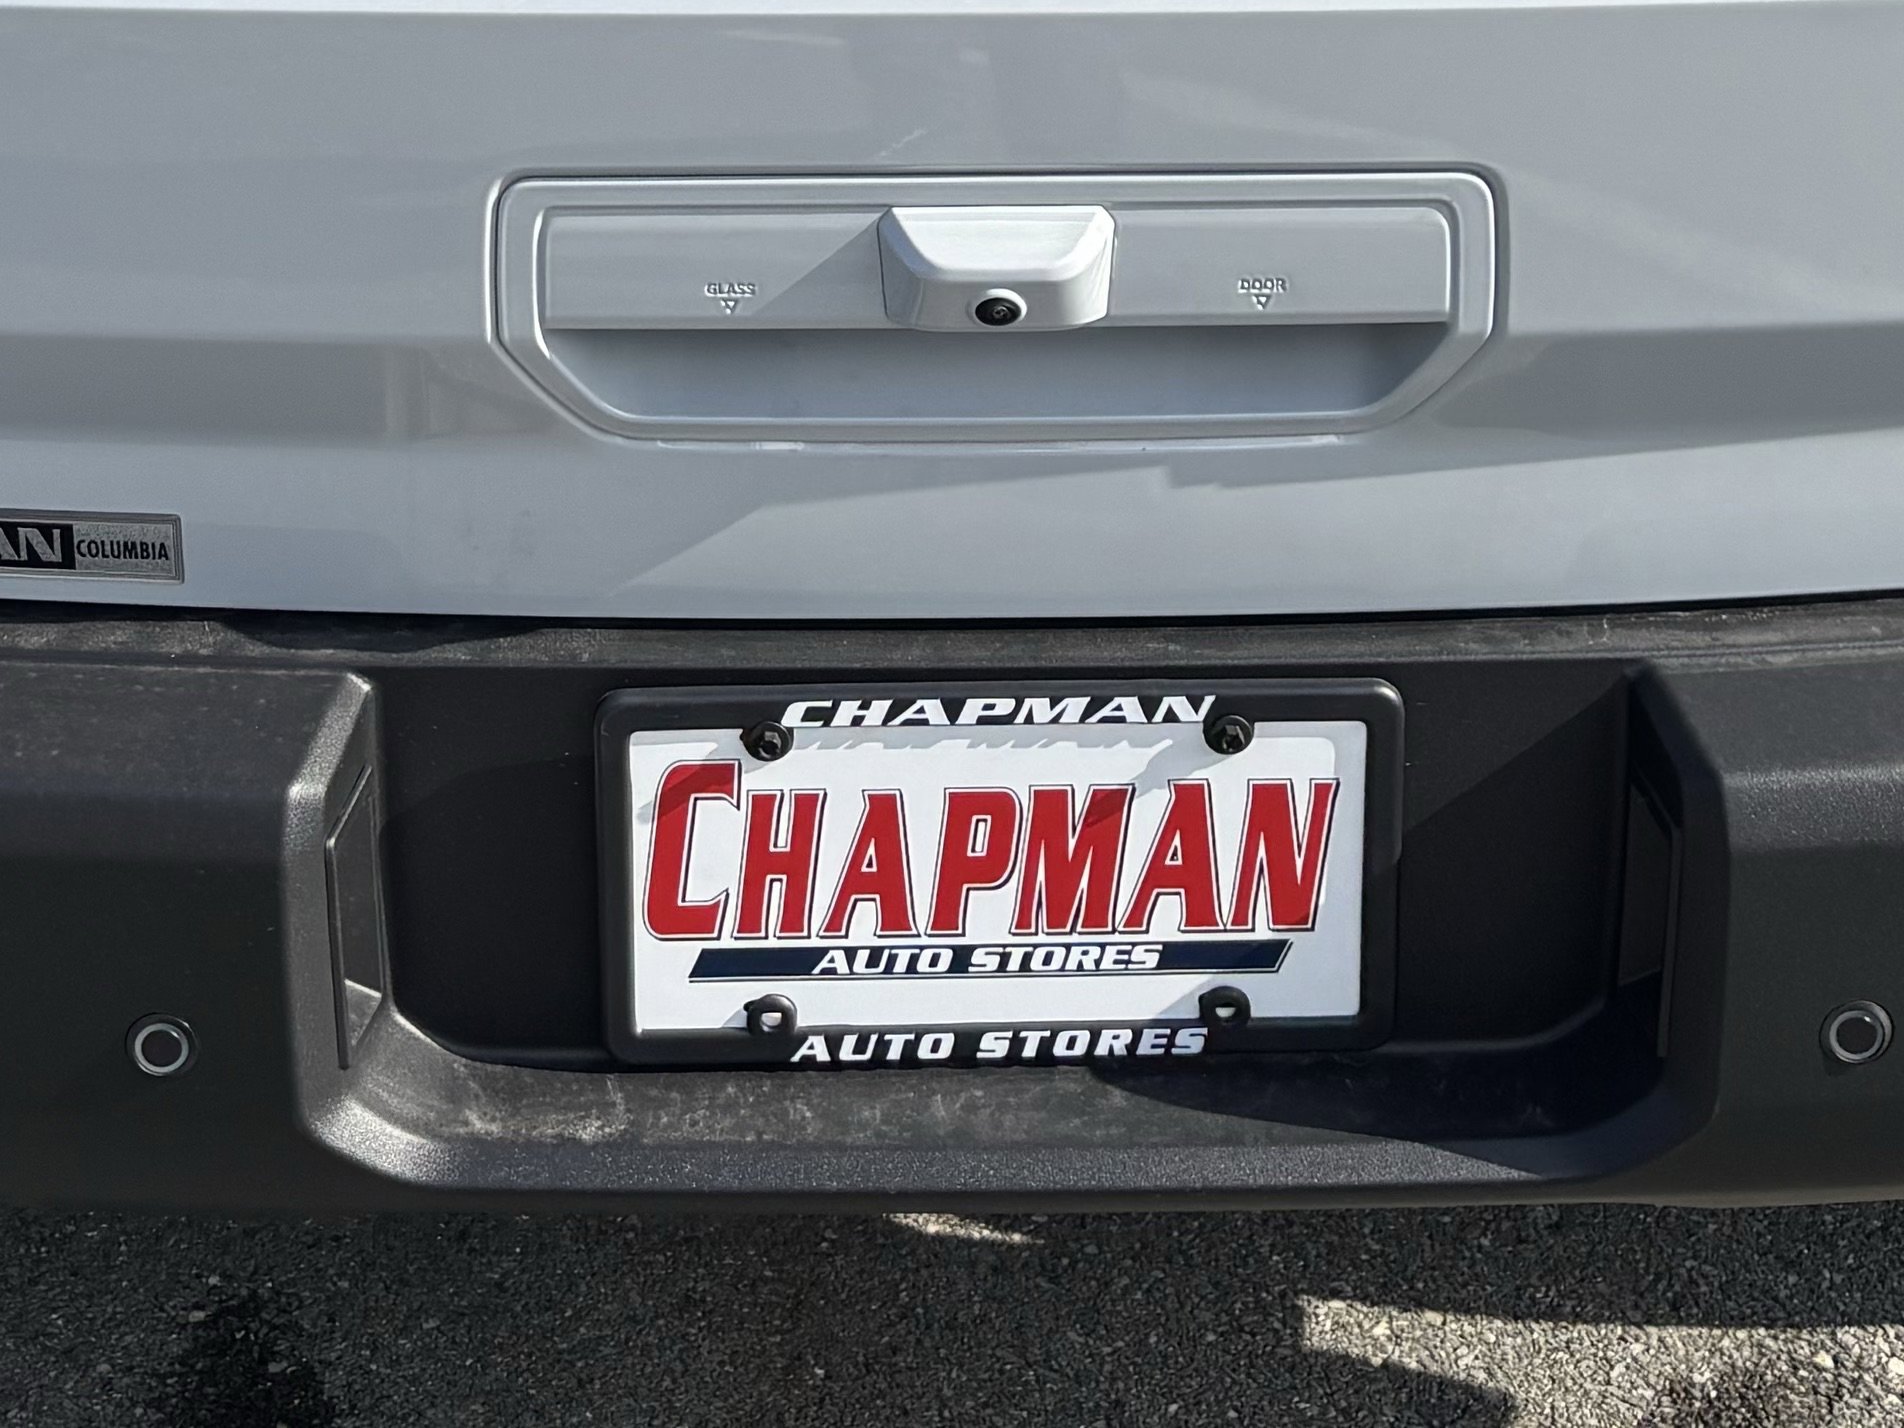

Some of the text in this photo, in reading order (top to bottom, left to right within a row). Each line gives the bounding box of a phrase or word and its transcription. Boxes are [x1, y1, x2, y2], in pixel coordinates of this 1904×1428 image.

[703, 282, 757, 297] GLASS
[1237, 277, 1287, 293] DOOR
[76, 539, 170, 562] COLUMBIA
[780, 693, 1217, 728] CHAPMAN
[643, 757, 1341, 942] CHAPMAN
[811, 944, 1163, 976] AUTO STORES
[789, 1026, 1209, 1063] AUTO STORES
